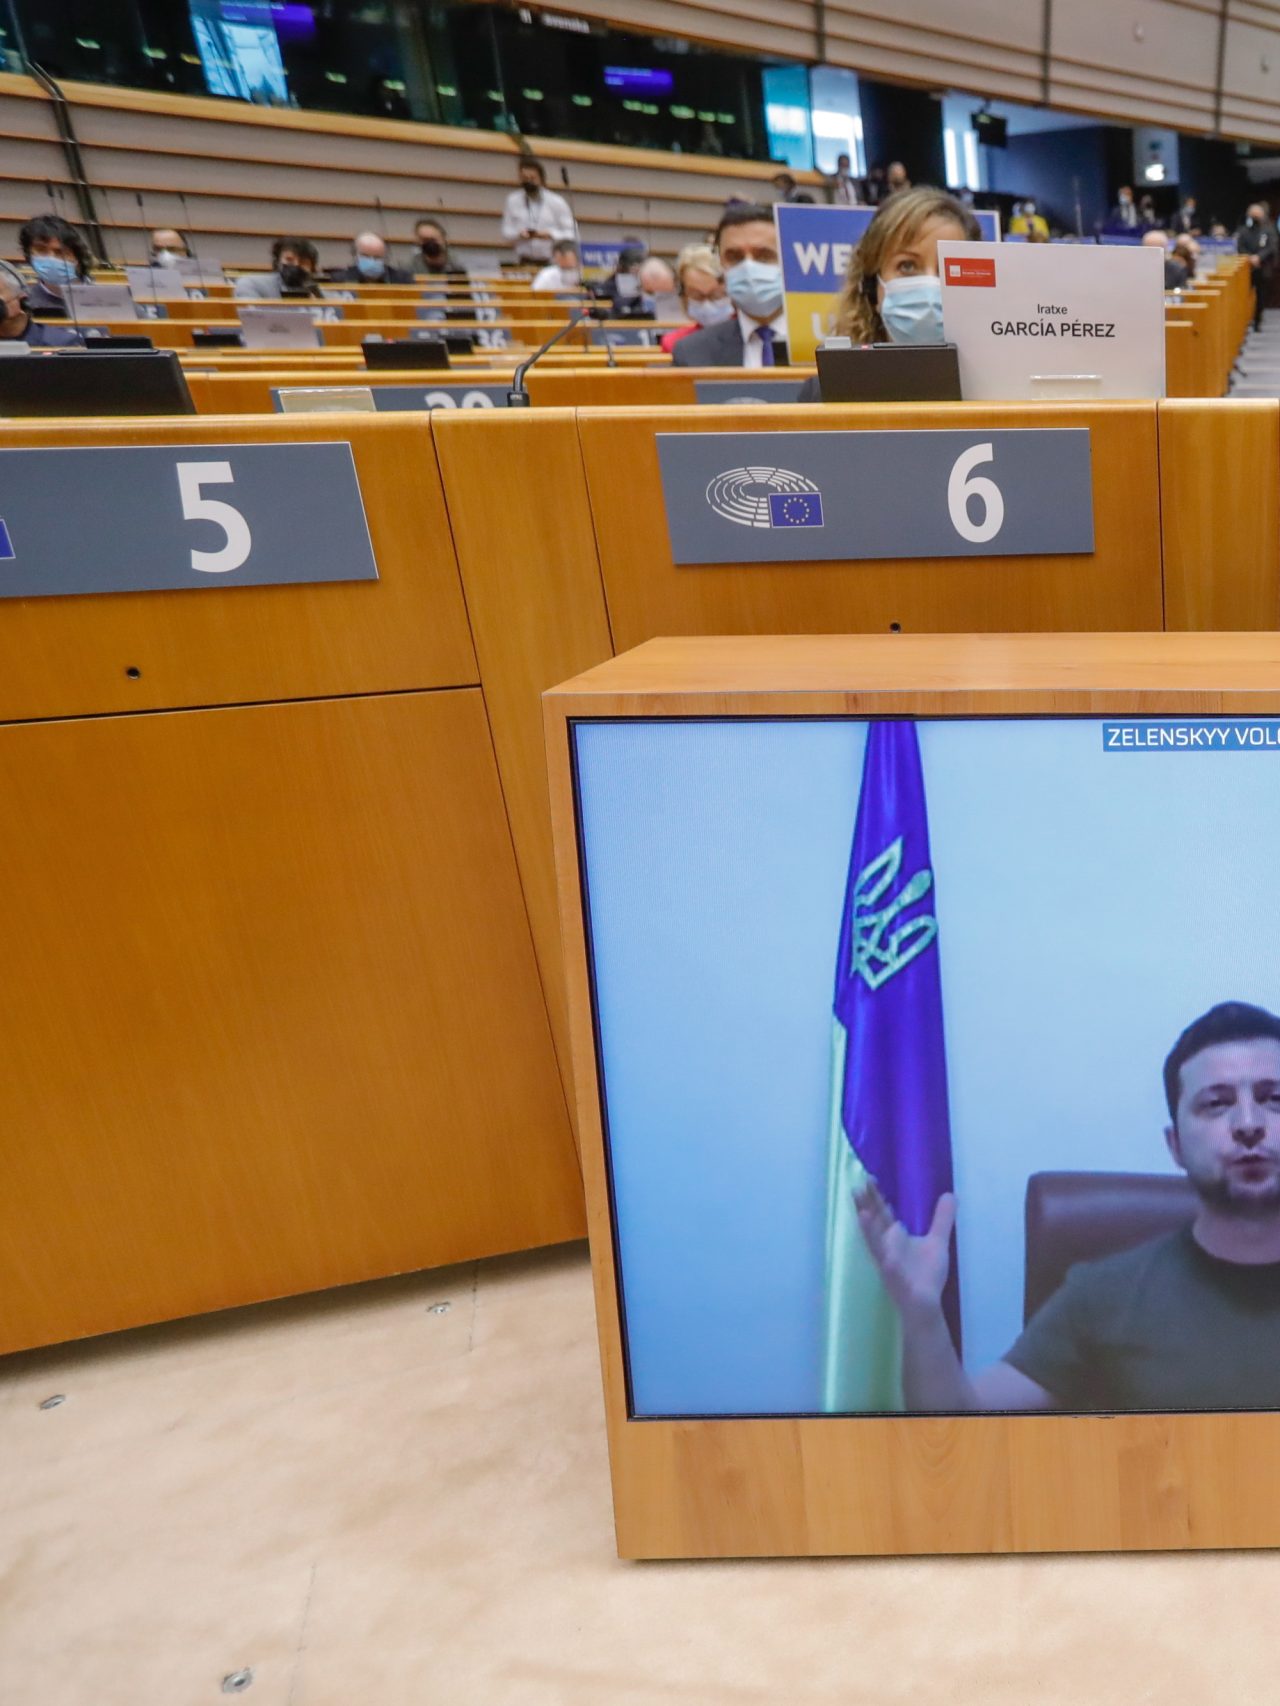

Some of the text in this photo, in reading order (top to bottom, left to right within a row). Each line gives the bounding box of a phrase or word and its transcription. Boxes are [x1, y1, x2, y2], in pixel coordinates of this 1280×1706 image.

[792, 241, 854, 276] WE
[1037, 303, 1068, 315] Iratxe
[991, 318, 1116, 338] GARCÍA PÉREZ
[947, 442, 1004, 543] 6
[176, 461, 252, 573] 5
[1108, 728, 1230, 746] ZELENSKYY
